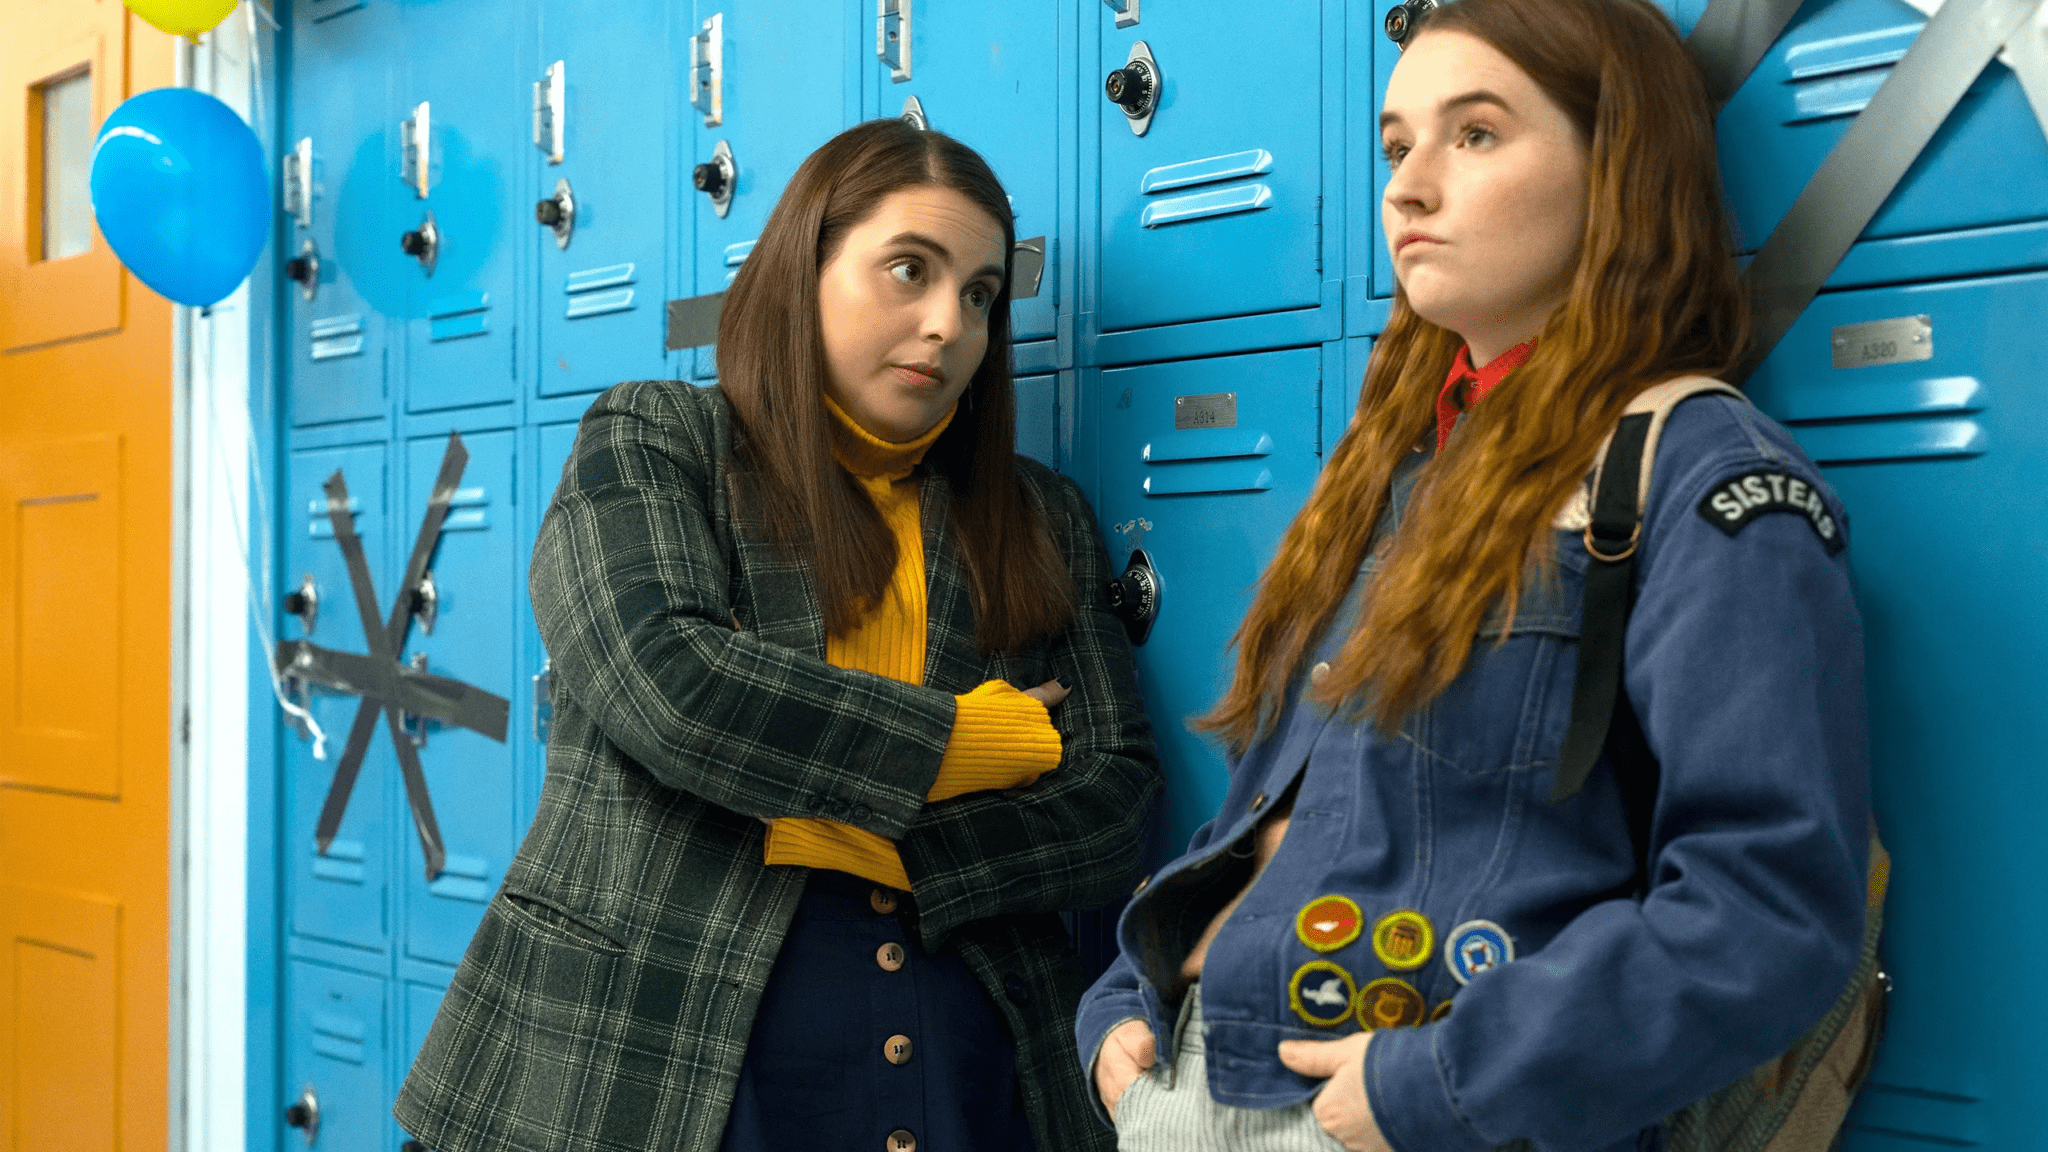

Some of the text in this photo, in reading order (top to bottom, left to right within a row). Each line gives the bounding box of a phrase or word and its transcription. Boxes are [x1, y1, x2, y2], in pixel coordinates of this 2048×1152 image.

[1862, 340, 1898, 360] A320
[1193, 410, 1216, 425] A314
[1710, 474, 1836, 540] SISTERS
